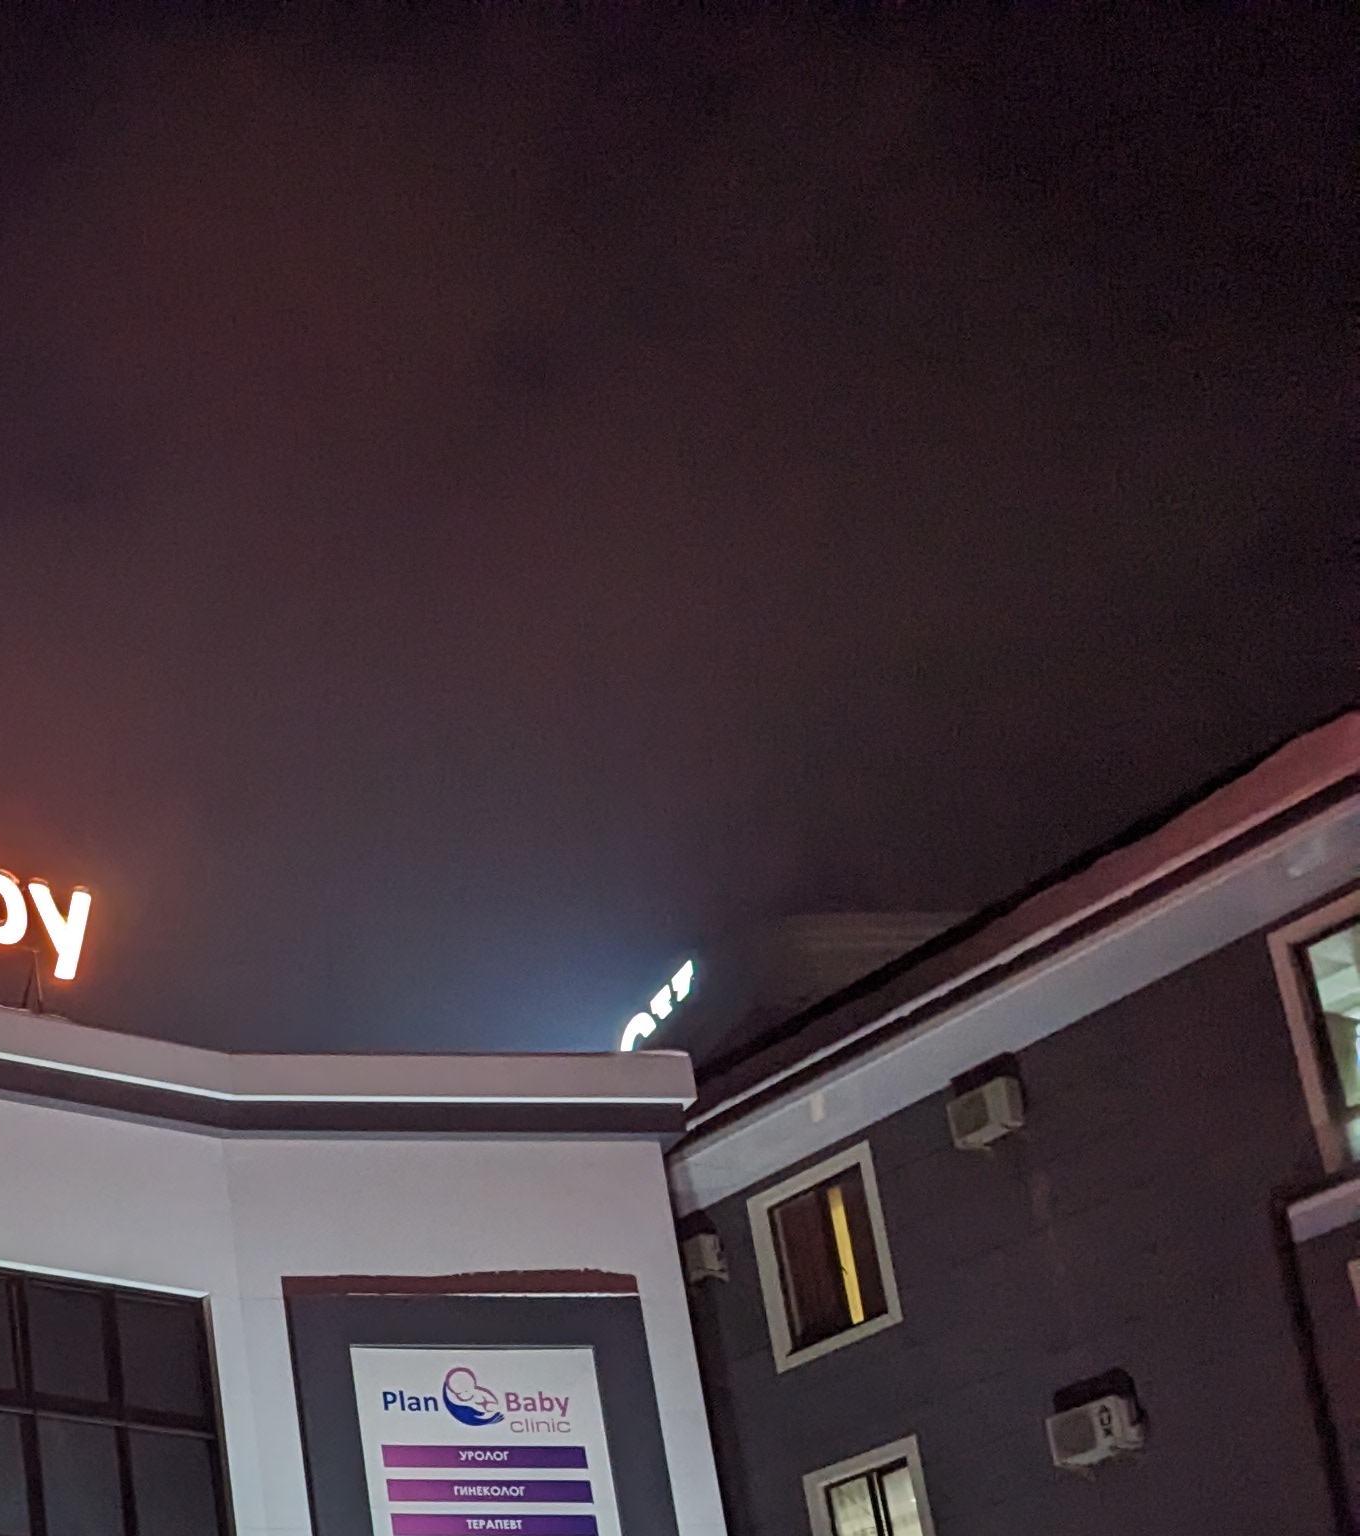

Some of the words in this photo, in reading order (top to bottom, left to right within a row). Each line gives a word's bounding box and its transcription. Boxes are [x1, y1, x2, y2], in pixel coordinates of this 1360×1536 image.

[382, 1390, 439, 1411] Plan
[505, 1391, 570, 1417] Baby
[509, 1418, 571, 1434] clinic
[458, 1450, 510, 1462] УРОЛОГ
[453, 1485, 525, 1498] ГИНЕКОЛОГ
[466, 1519, 523, 1531] ТЕРАПЕВТ
